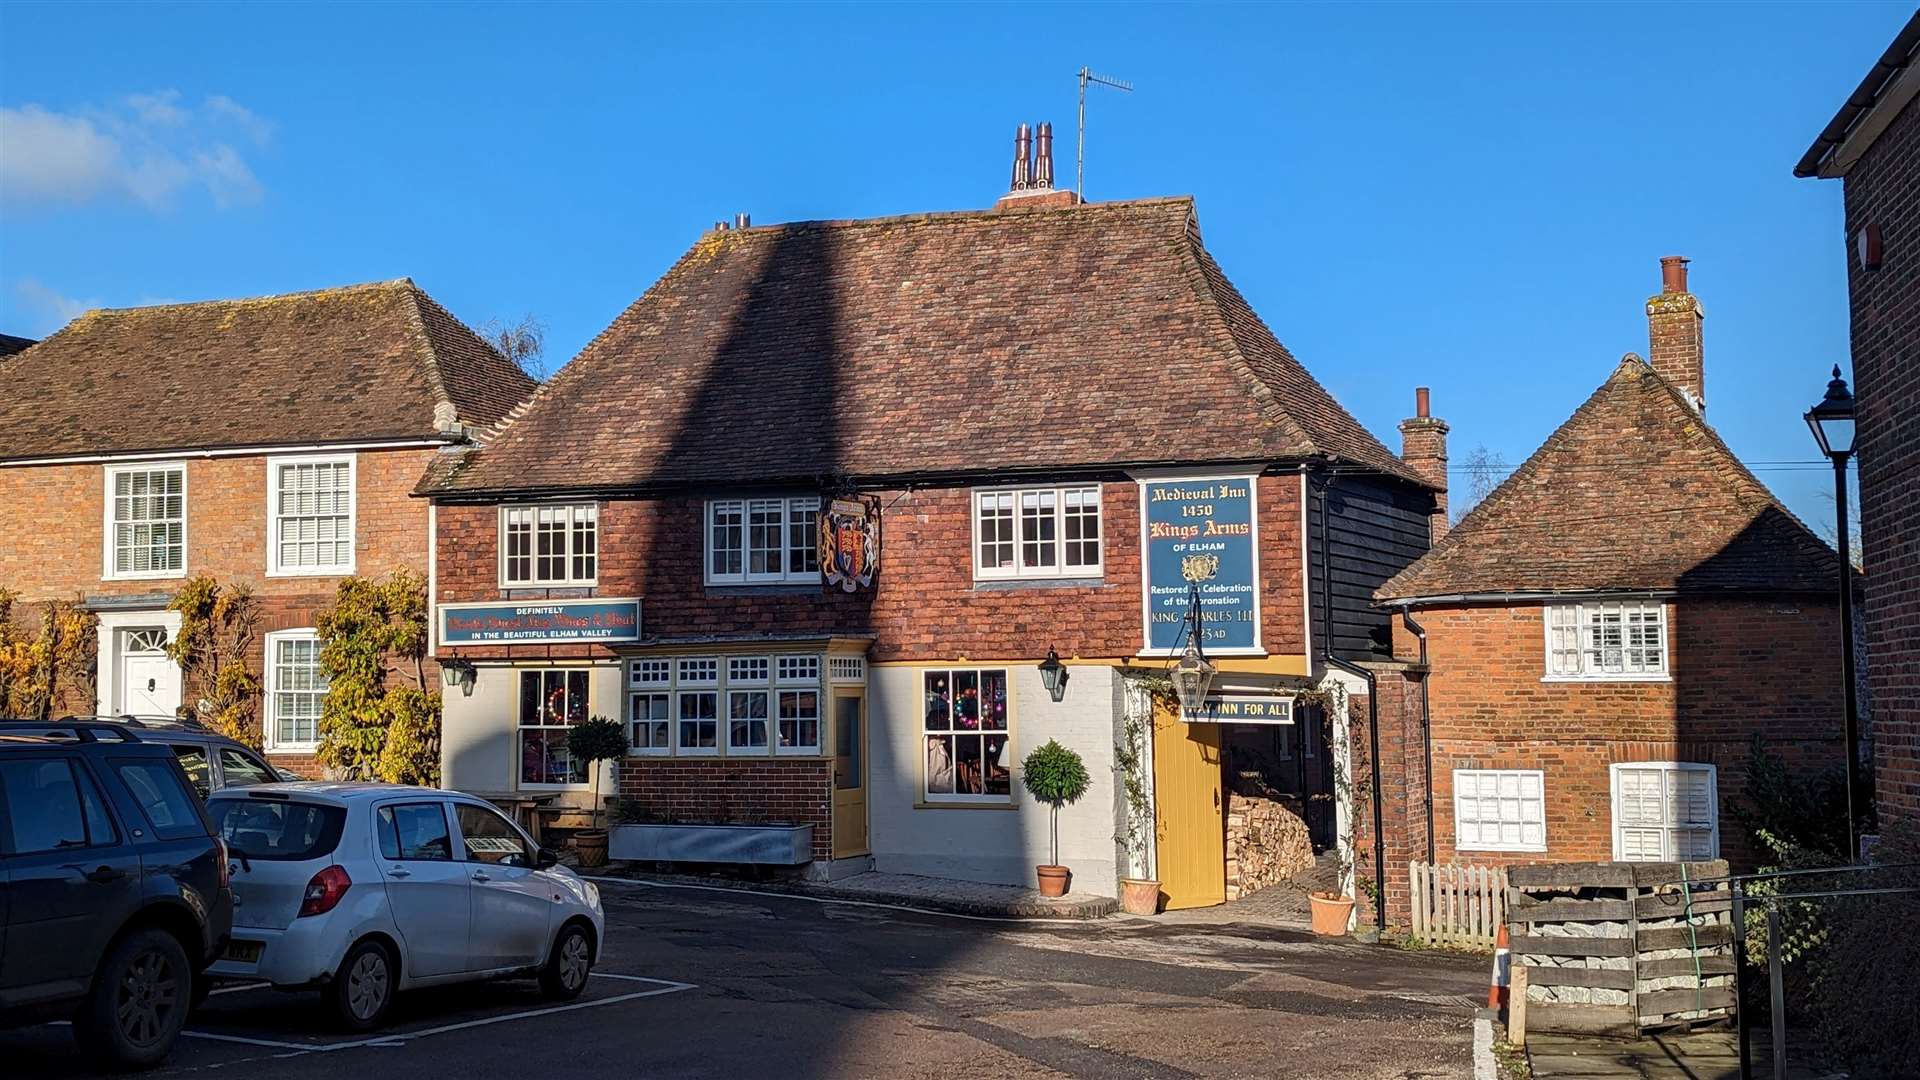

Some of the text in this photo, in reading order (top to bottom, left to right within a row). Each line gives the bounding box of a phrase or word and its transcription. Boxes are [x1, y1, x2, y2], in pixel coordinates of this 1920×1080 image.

[1151, 485, 1247, 502] Medieval Inn
[1182, 504, 1213, 517] 1450
[1149, 519, 1249, 540] Kings Arms
[1173, 543, 1225, 552] OF ELHAM
[1151, 585, 1188, 594] Restored
[1203, 584, 1252, 593] Celebration
[1163, 597, 1174, 605] of
[516, 607, 564, 615] DEFINITELY
[1152, 610, 1252, 622] KING CARLES III
[484, 631, 500, 639] THE
[503, 630, 547, 639] BEAUTIFUL
[581, 629, 613, 637] VALLEY
[1217, 703, 1238, 714] INN
[1244, 703, 1264, 715] FOR
[1268, 704, 1288, 716] ALL
